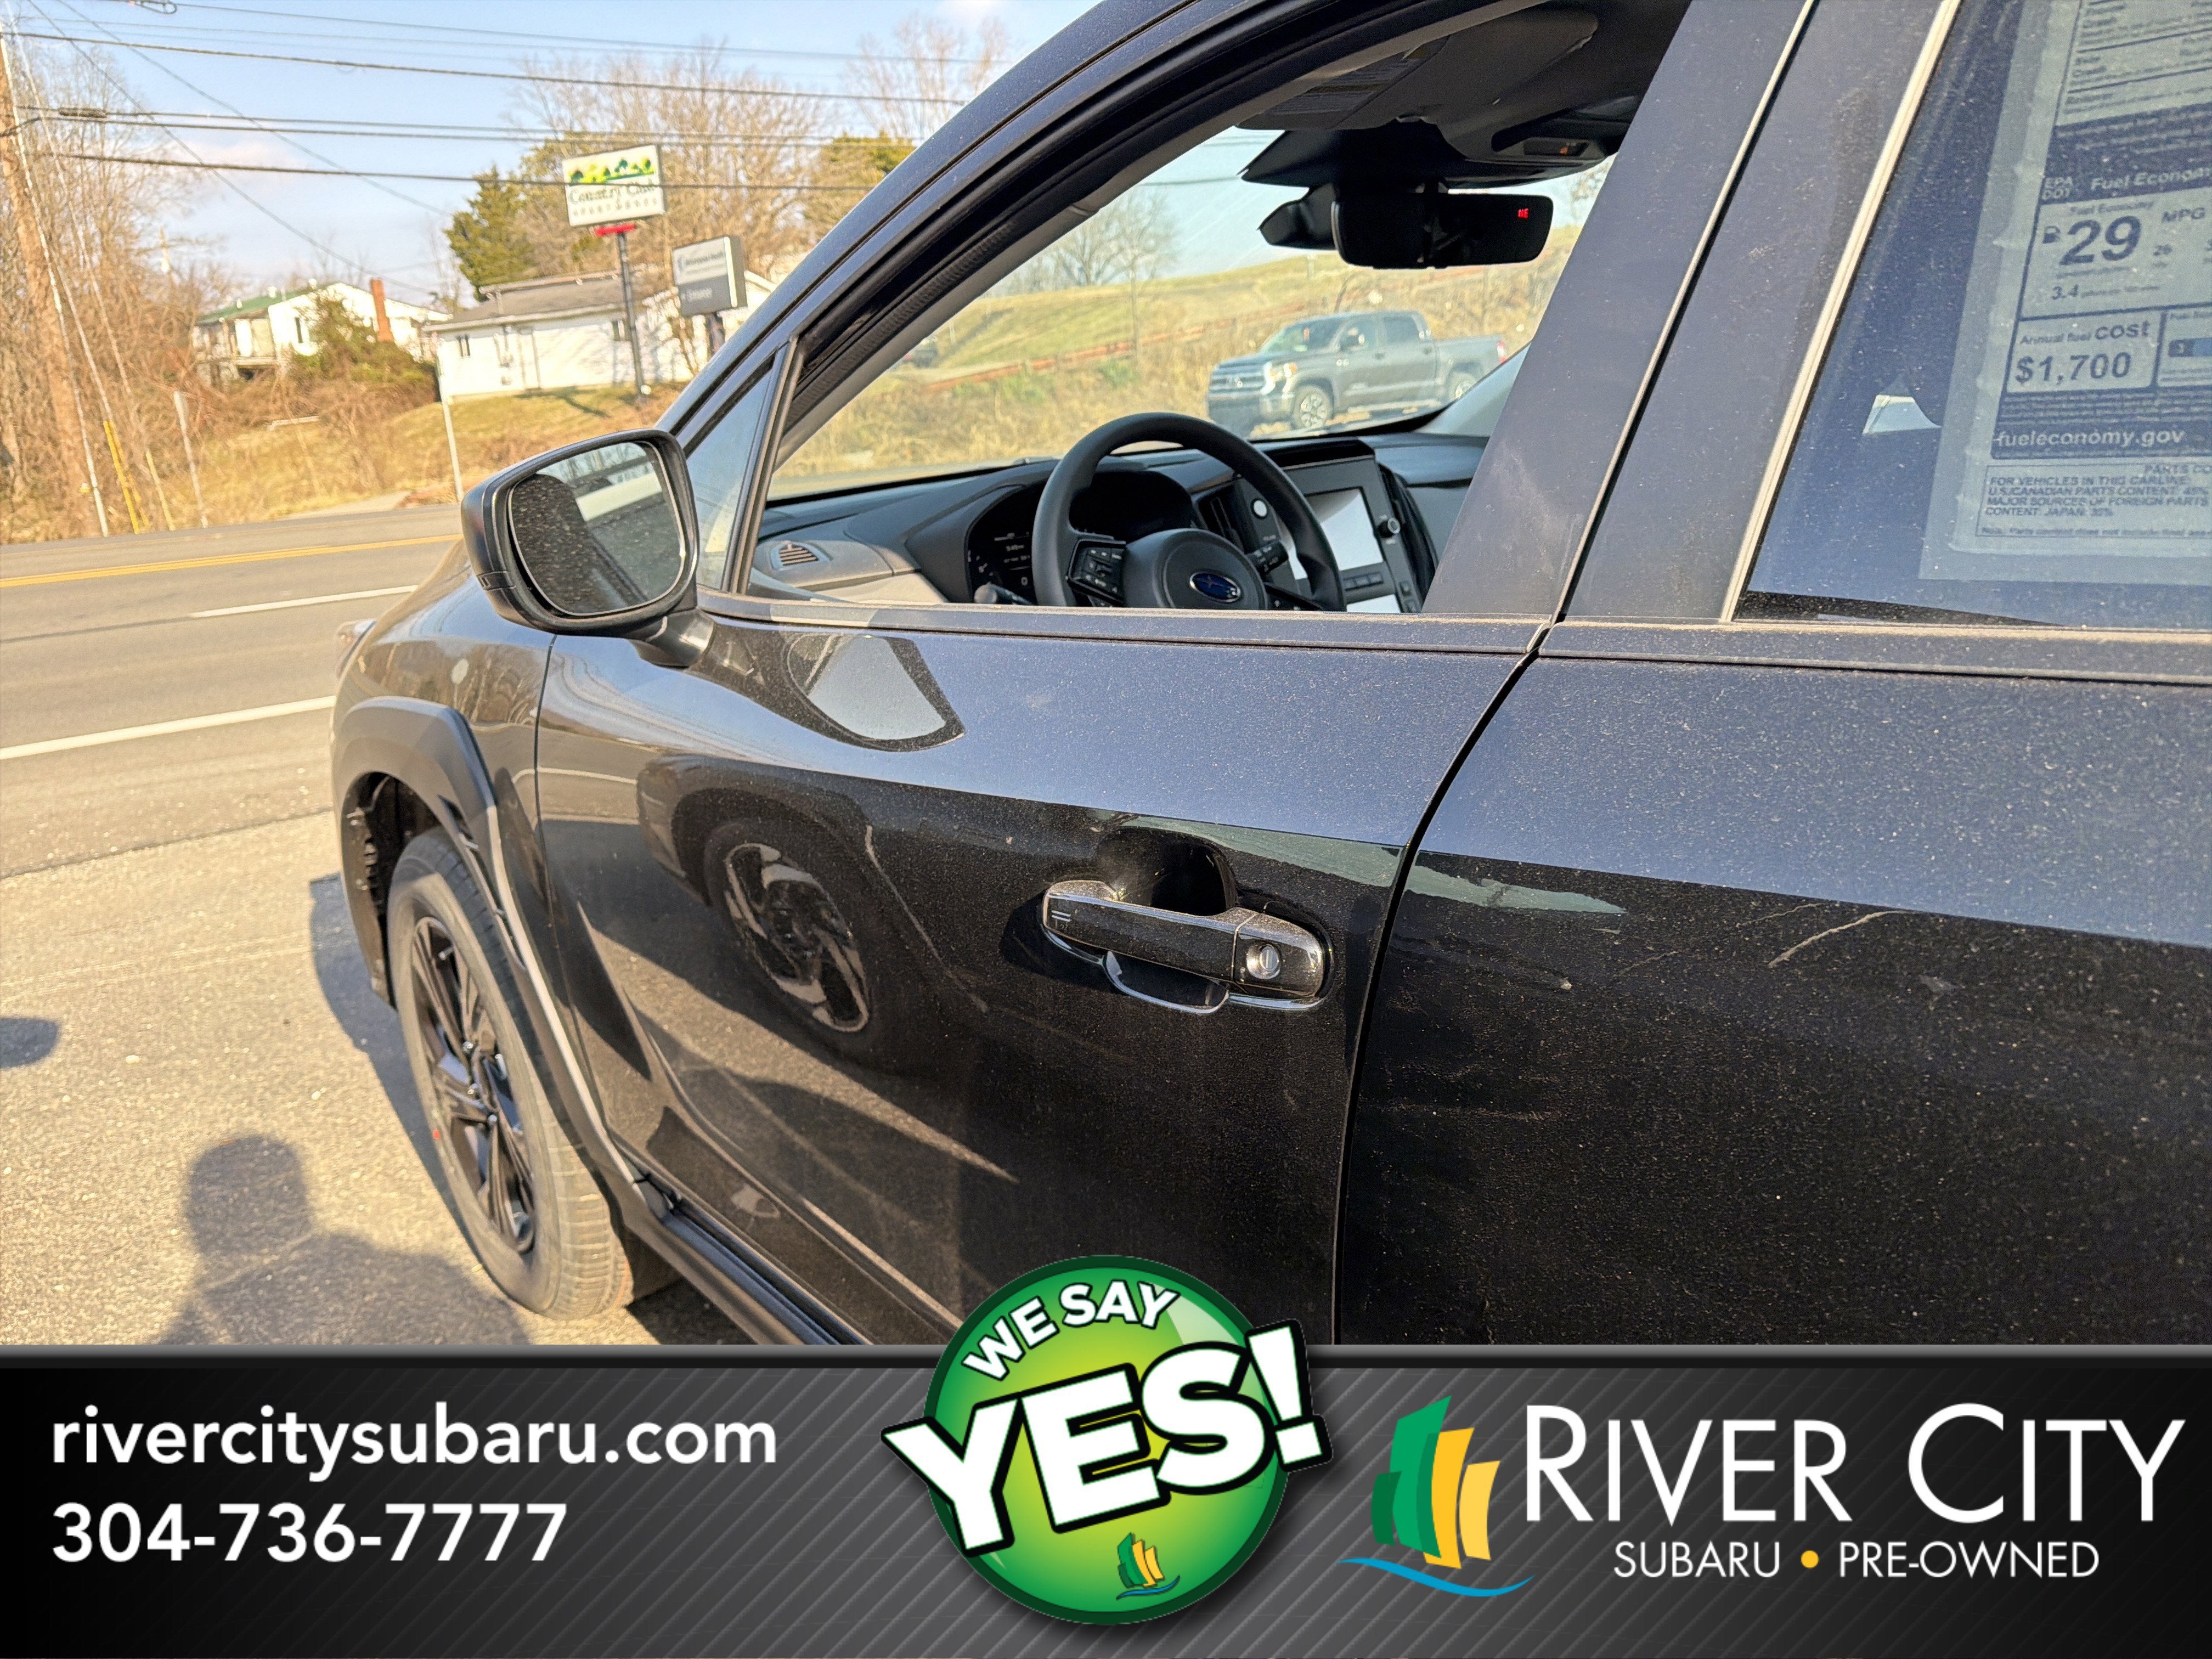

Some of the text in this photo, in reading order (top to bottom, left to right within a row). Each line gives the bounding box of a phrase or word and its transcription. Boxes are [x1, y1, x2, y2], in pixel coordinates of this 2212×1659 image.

[2045, 177, 2073, 188] EPA
[2091, 175, 2130, 190] Fuel
[569, 187, 621, 206] Country
[2059, 207, 2205, 266] 29 MPG
[2051, 285, 2079, 300] 3.4
[2021, 320, 2150, 344] Annual fuel cost
[2016, 352, 2132, 385] $1,700
[1997, 429, 2185, 448] fueleconomy.gov
[2145, 464, 2188, 474] PARTS
[1991, 477, 2014, 486] FOR
[2018, 477, 2078, 486] VEHICLES
[2099, 476, 2125, 485] THIS
[2075, 487, 2115, 495] PARTS
[1988, 497, 2027, 505] MAJOR
[2030, 497, 2086, 505] SOURCES
[2109, 497, 2164, 505] FOREIGN
[2167, 496, 2209, 506] PARTS
